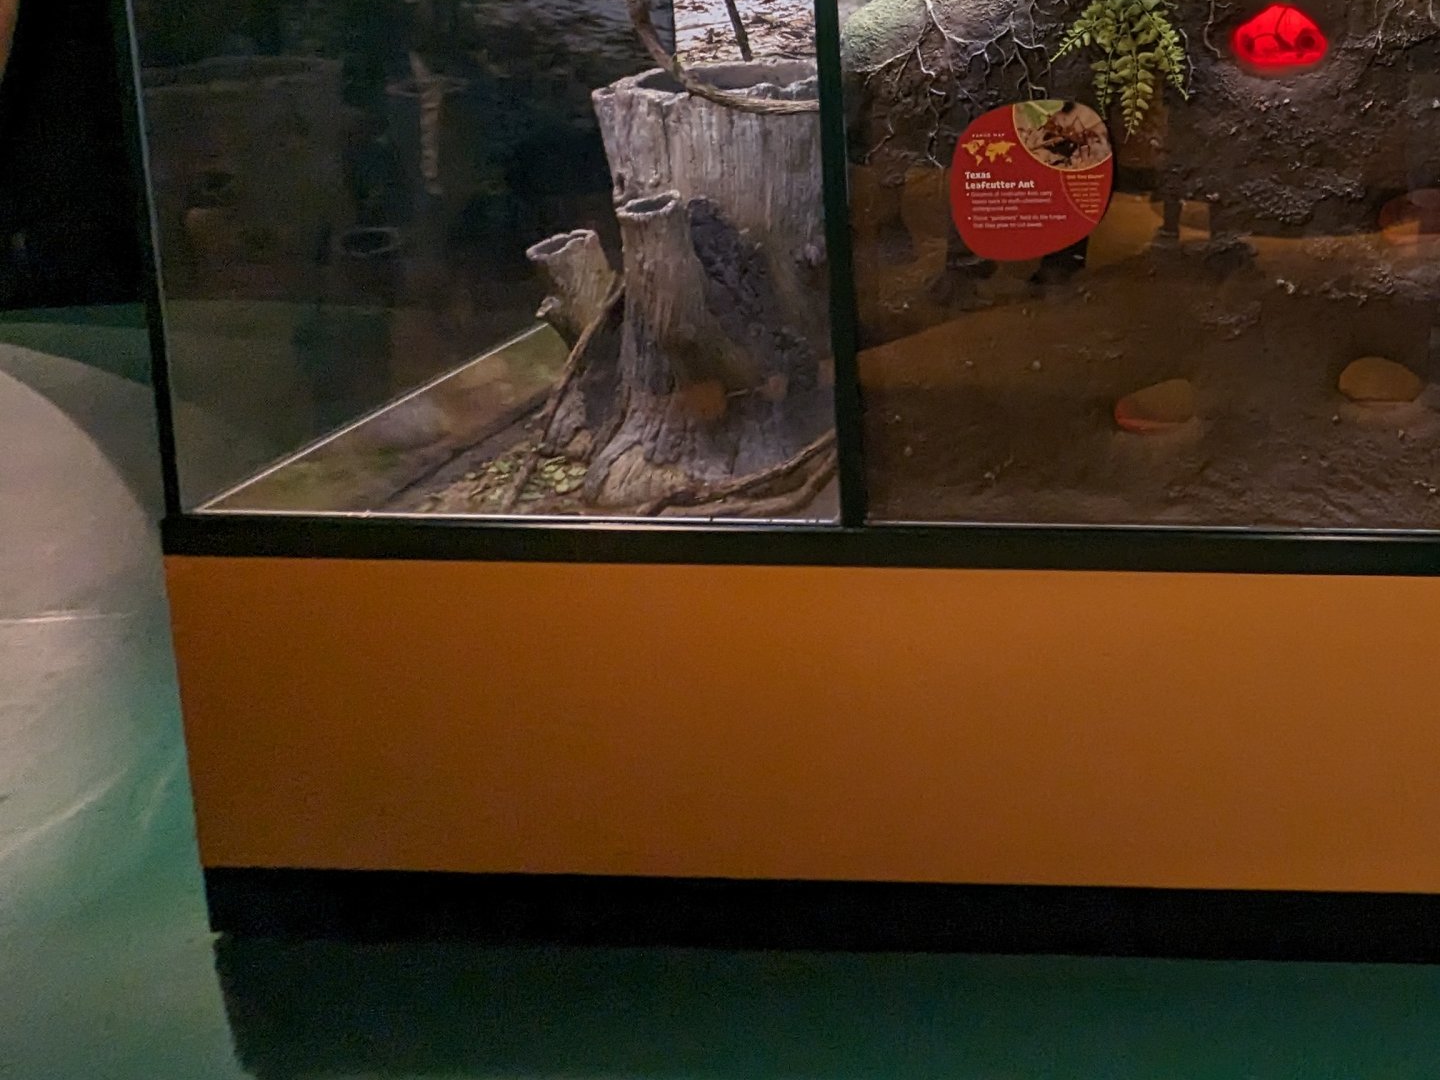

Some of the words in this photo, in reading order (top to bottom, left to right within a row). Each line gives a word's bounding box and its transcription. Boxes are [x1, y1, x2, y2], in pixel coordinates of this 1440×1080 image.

[965, 171, 991, 180] Texas
[965, 181, 1016, 190] Leafcutter
[1018, 180, 1035, 189] Ant
